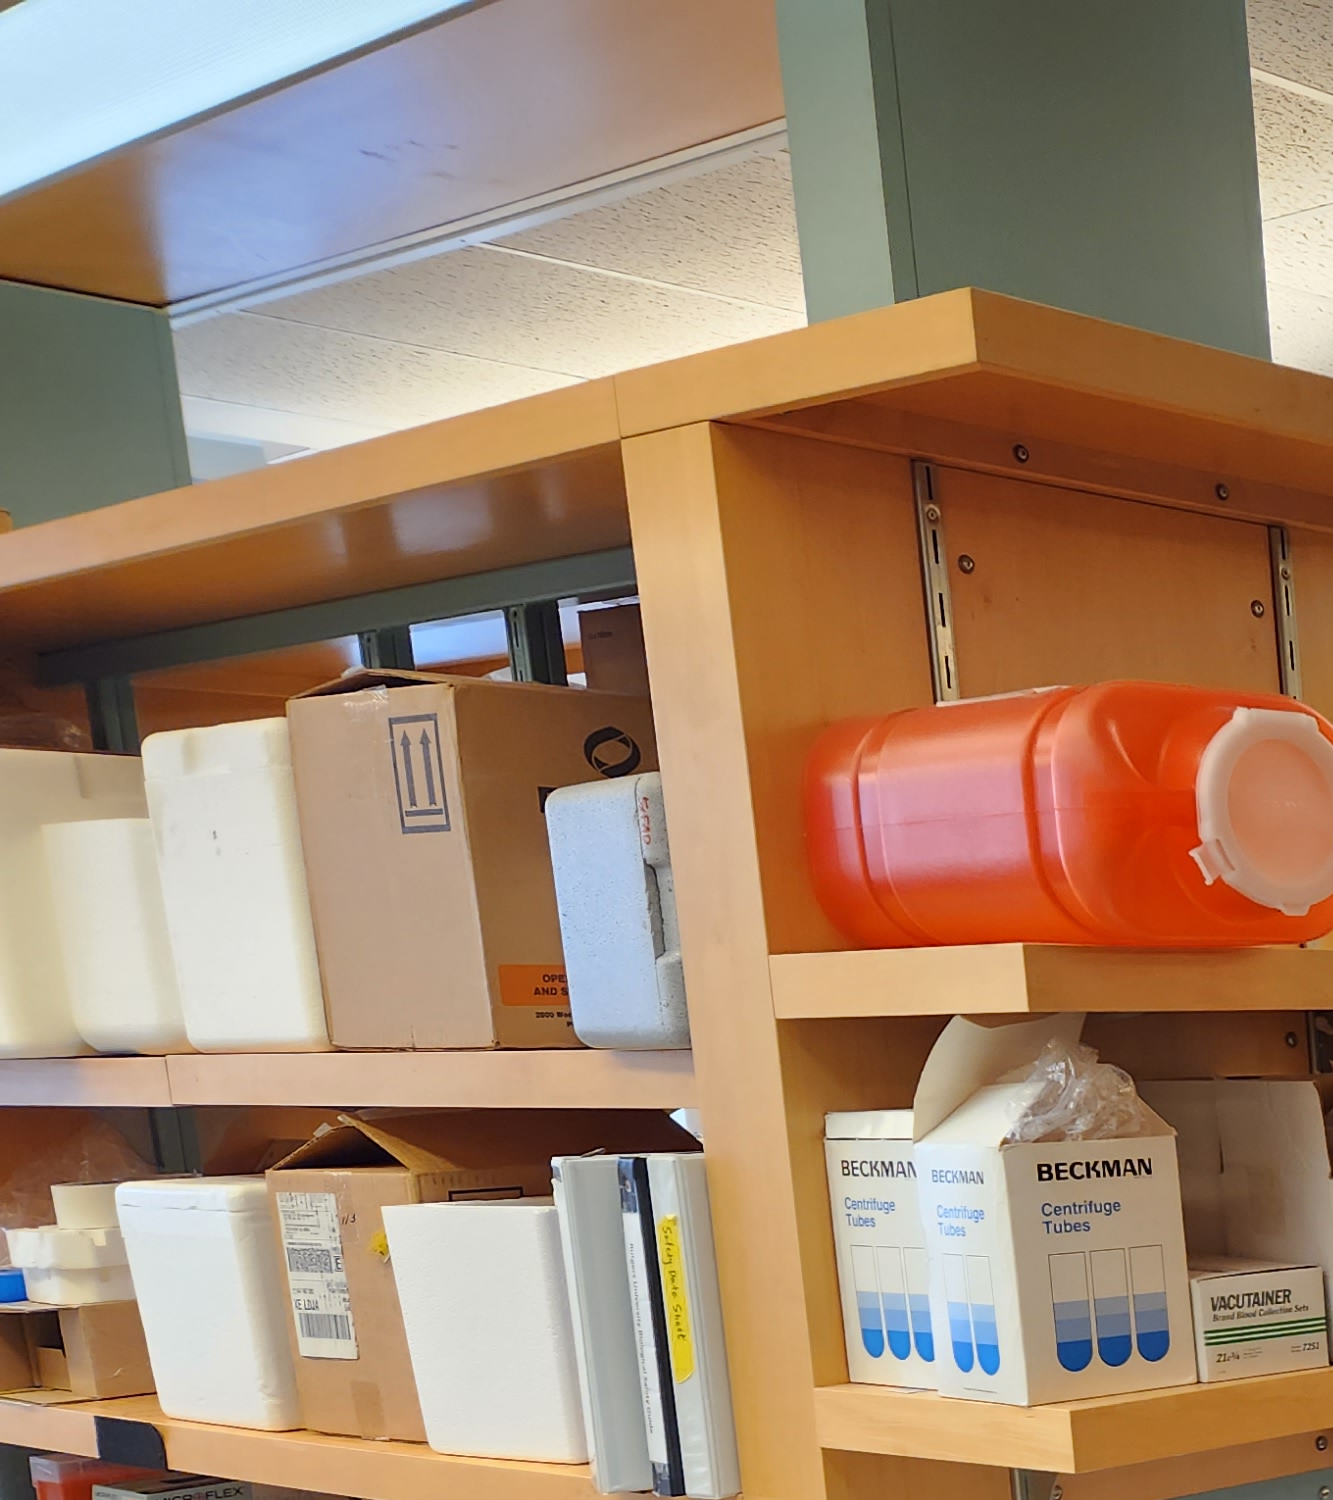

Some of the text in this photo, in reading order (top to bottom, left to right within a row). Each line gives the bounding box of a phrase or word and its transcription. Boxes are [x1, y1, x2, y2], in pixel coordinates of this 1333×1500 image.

[543, 974, 567, 983] OPE
[533, 987, 558, 996] AND
[931, 1169, 985, 1185] BECKMAN
[1037, 1157, 1153, 1182] BECKMAN
[844, 1196, 896, 1215] Centrifuge
[936, 1204, 985, 1223] Centrifuge
[1041, 1200, 1122, 1217] Centrifuge
[845, 1214, 876, 1228] Tubes
[937, 1222, 966, 1237] Tubes
[1042, 1219, 1091, 1234] Tubes
[662, 1225, 674, 1266] Safety
[632, 1280, 642, 1328] University
[1210, 1289, 1292, 1312] VACUTAINER
[1236, 1309, 1257, 1320] Blood
[1293, 1304, 1309, 1313] Sets
[637, 1330, 648, 1374] Biological
[642, 1376, 651, 1406] Safety
